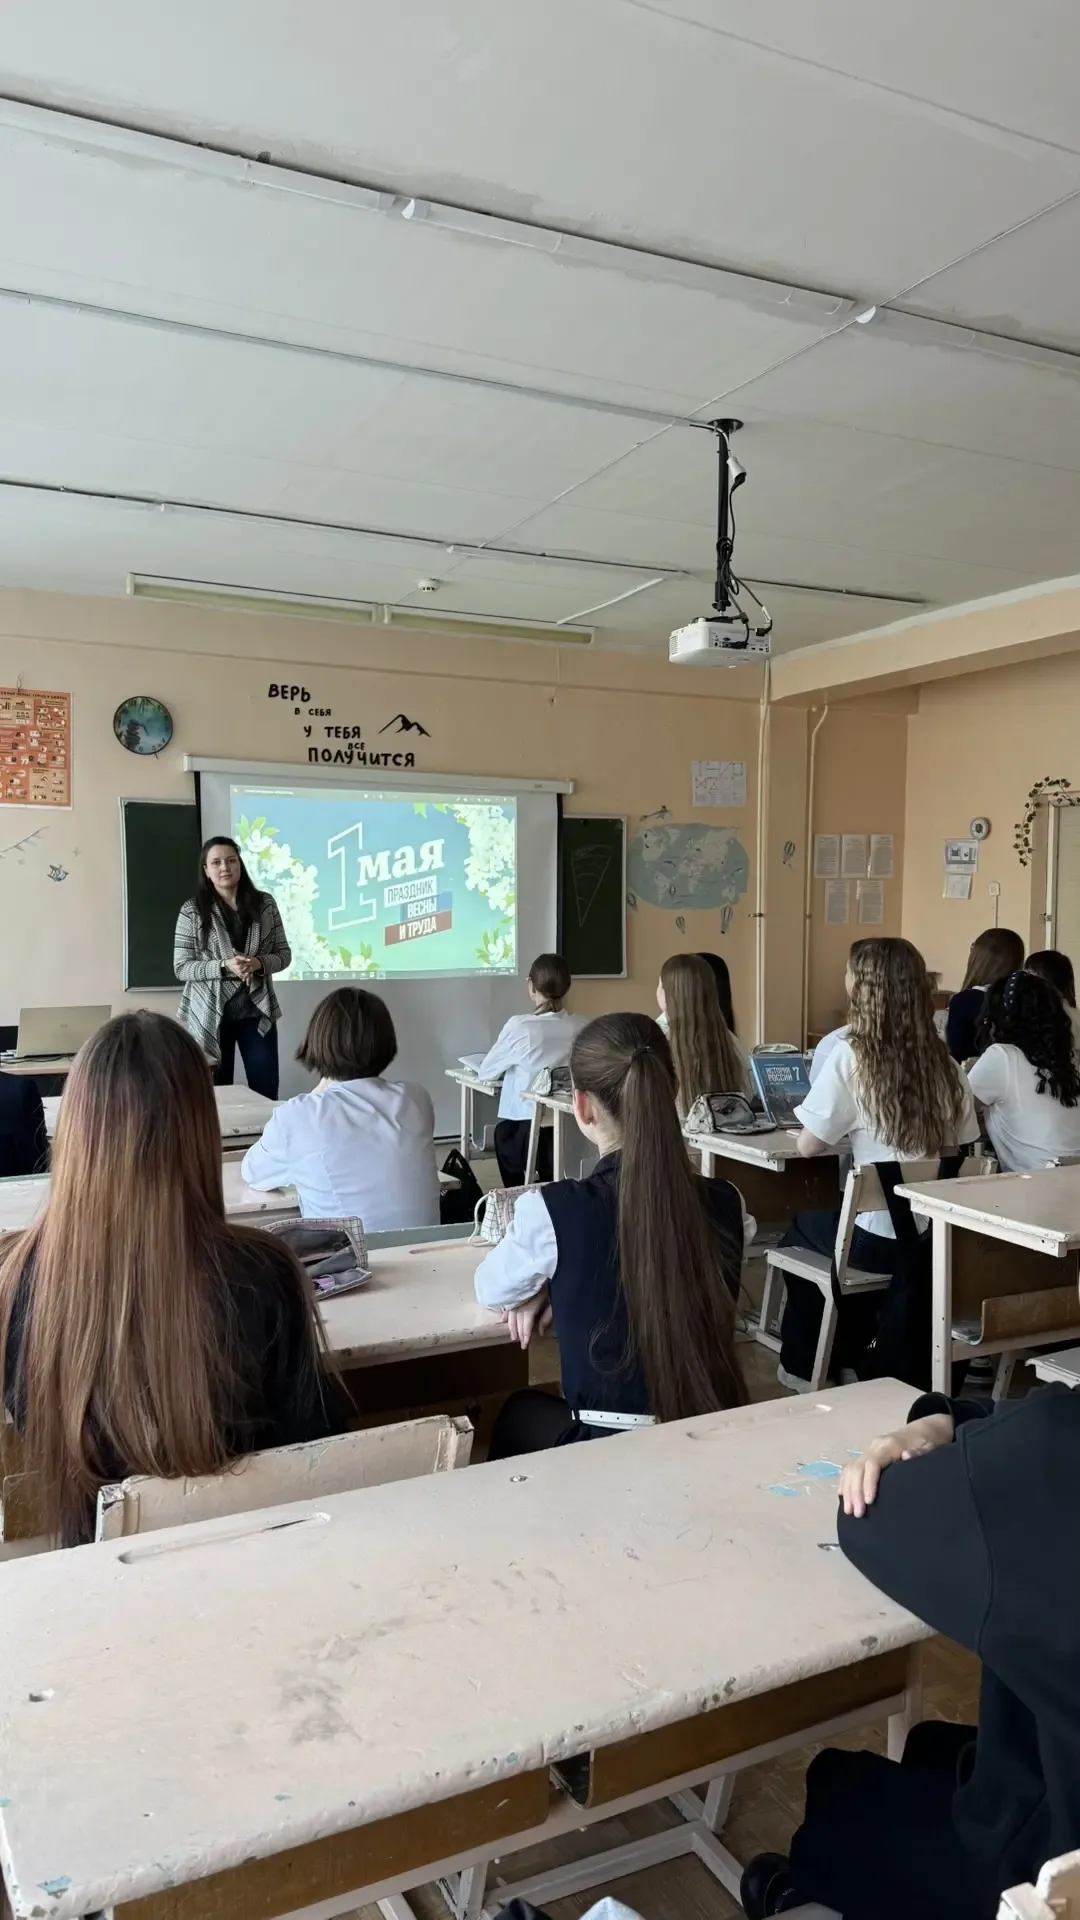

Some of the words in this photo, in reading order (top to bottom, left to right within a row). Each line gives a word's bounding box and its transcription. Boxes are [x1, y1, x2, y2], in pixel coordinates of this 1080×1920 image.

[268, 683, 311, 703] ВЕРЬ
[294, 707, 300, 716] В
[308, 708, 332, 717] СЕБЯ
[303, 725, 312, 738] У
[324, 726, 361, 739] ТЕБЯ
[347, 742, 365, 751] ВСЕ
[308, 747, 415, 767] ПОЛУЧИТСЯ
[327, 821, 377, 931] 1
[356, 838, 445, 887] мая
[387, 879, 434, 904] ПРАЗДНИК
[407, 897, 437, 919] ВЕСНЫ
[399, 923, 406, 941] И
[407, 916, 437, 938] ТРУДА
[768, 1074, 793, 1082] РОССИИ
[792, 1066, 800, 1081] 7
